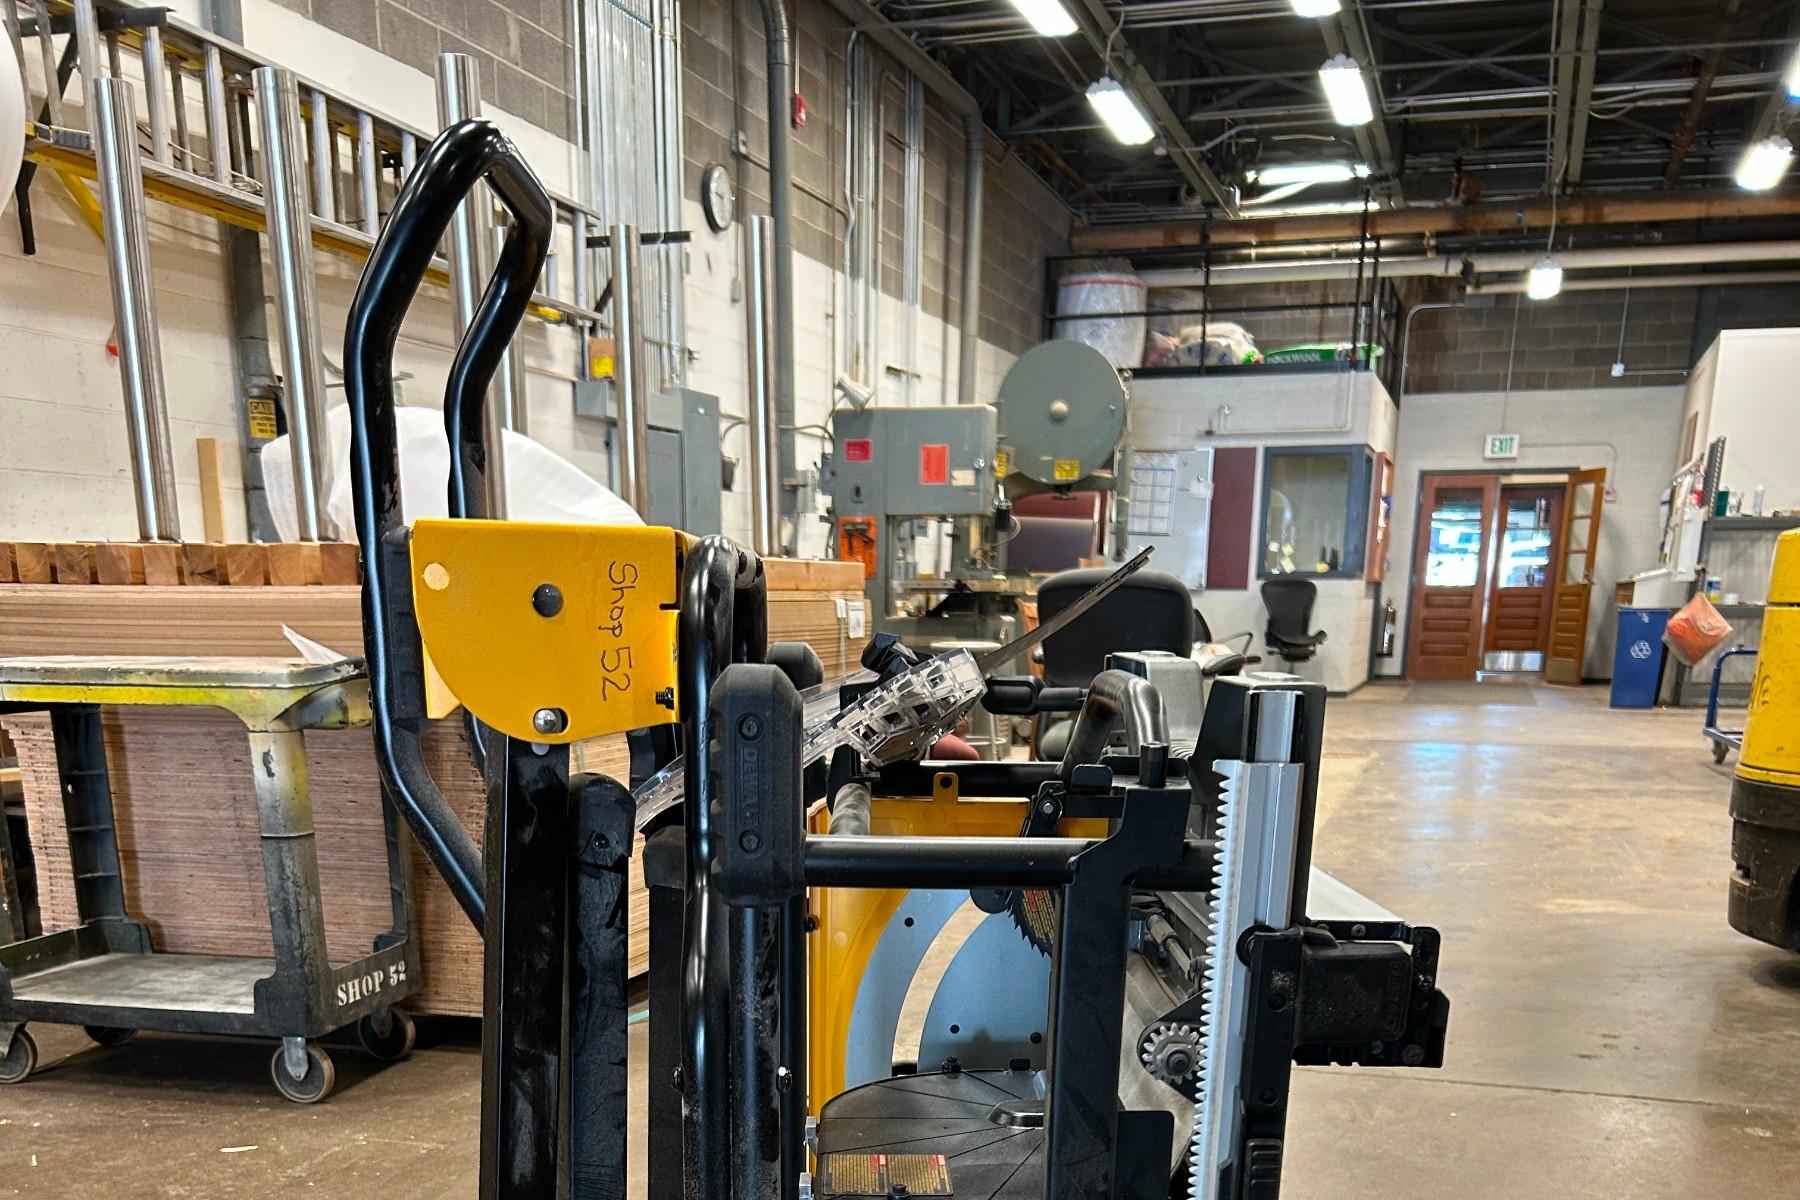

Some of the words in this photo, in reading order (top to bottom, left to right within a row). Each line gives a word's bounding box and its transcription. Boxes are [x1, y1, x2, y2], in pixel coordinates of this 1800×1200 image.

[1491, 437, 1515, 454] EXIT
[598, 560, 638, 638] Shop
[600, 646, 633, 702] 52
[337, 969, 384, 1006] SHOP
[389, 960, 406, 986] 52
